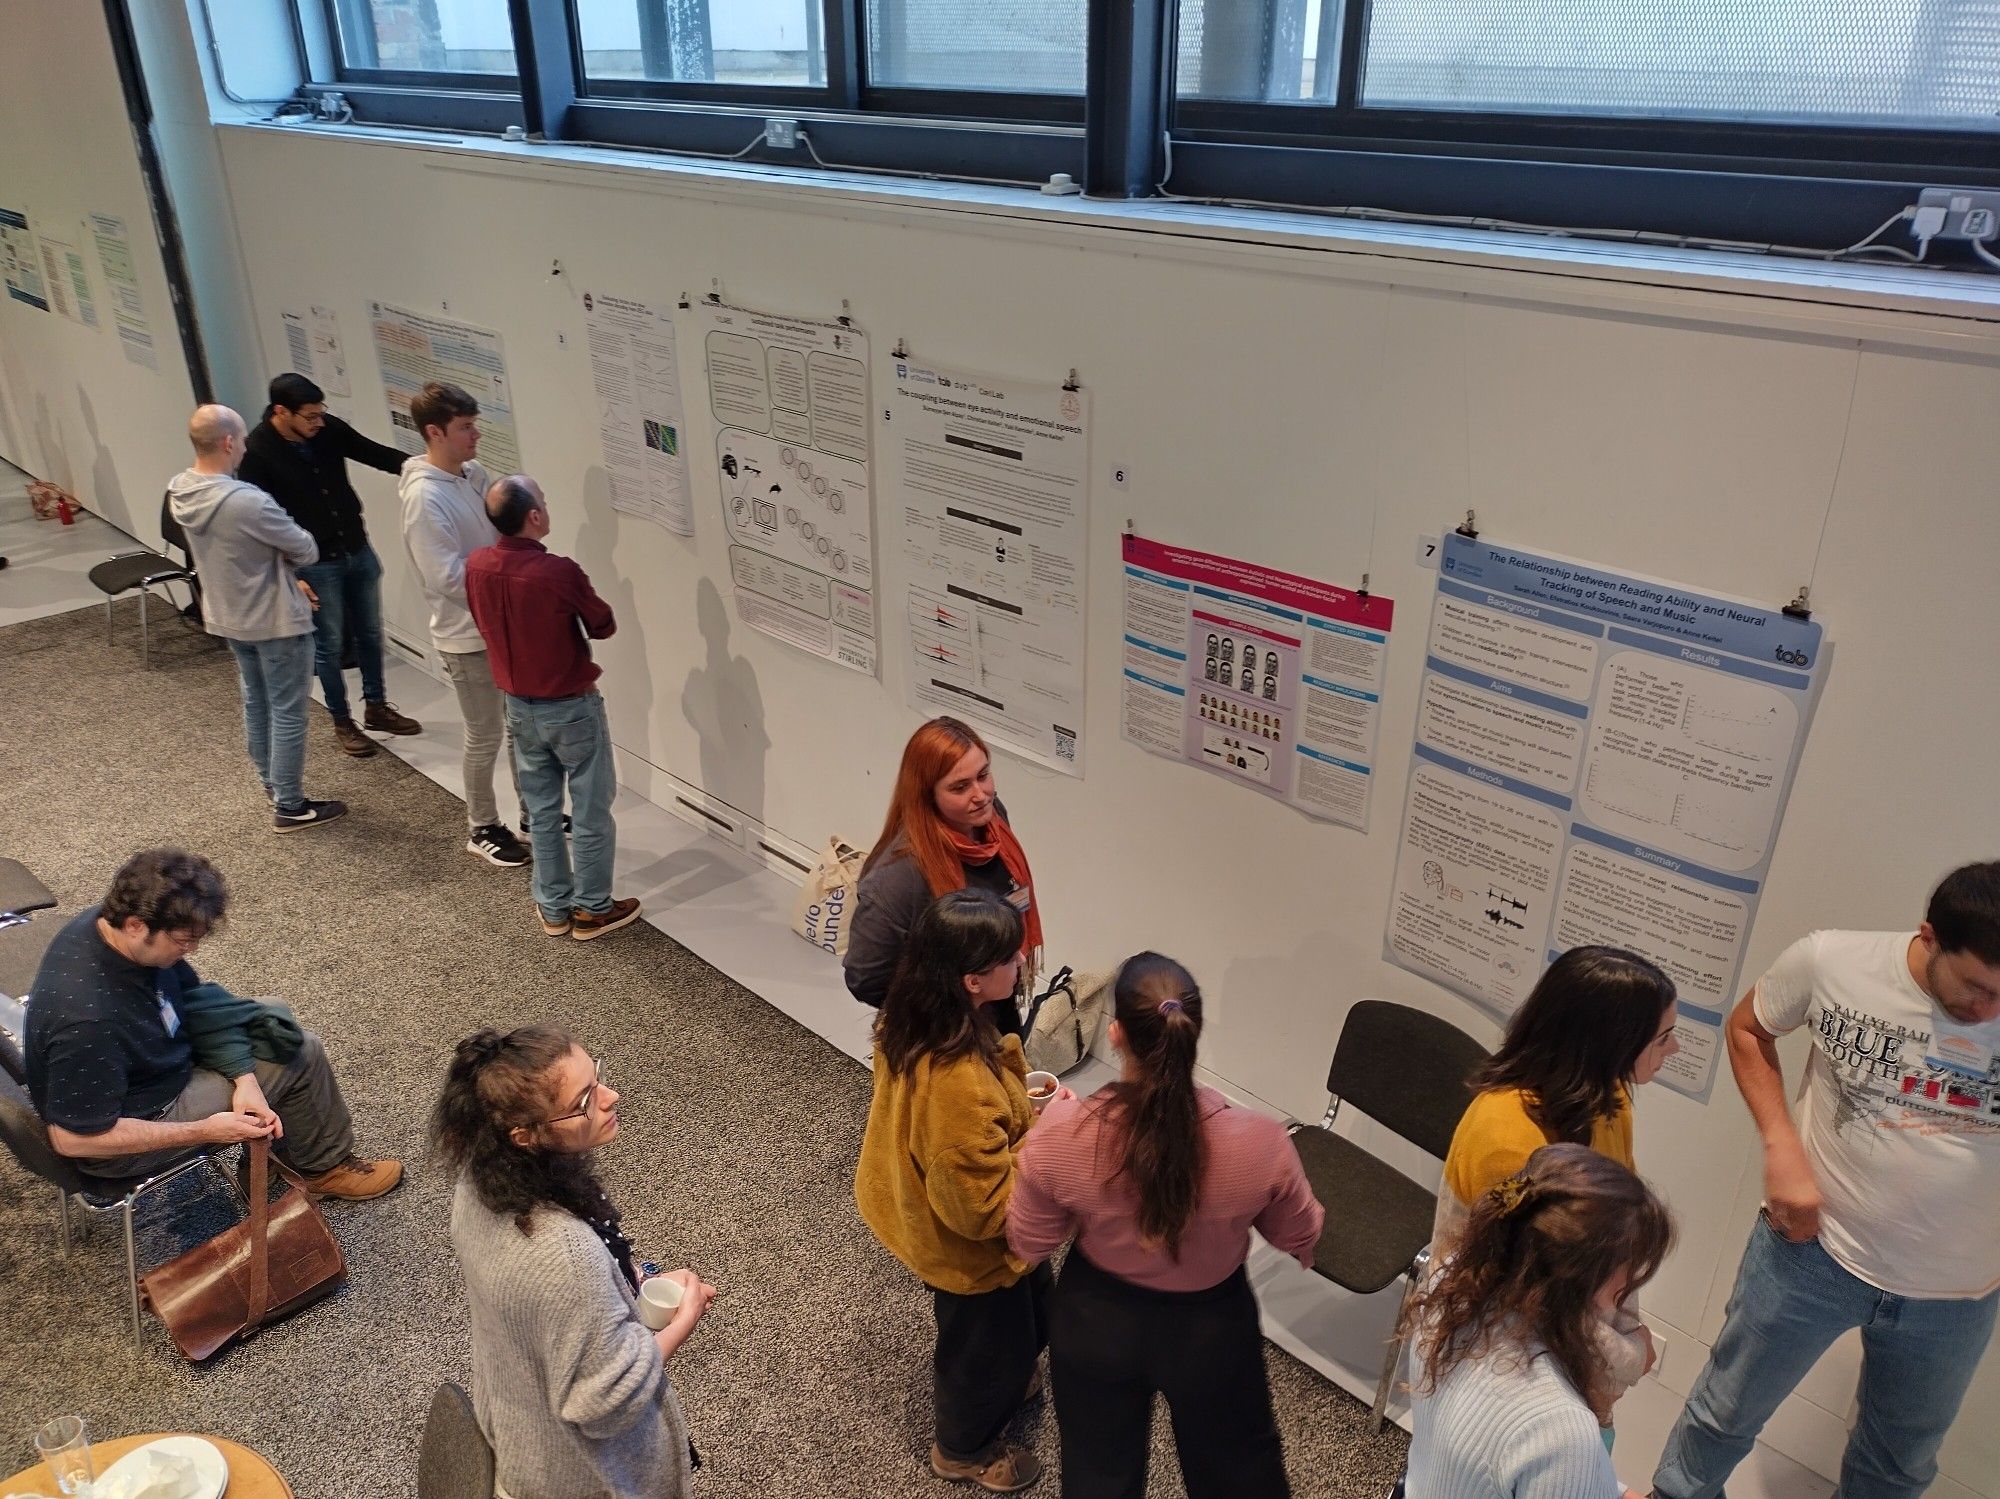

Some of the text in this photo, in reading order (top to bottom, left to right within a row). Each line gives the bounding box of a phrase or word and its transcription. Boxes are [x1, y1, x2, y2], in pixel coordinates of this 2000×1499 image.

[884, 410, 891, 421] 5
[896, 386, 909, 396] The
[910, 389, 937, 404] coupling
[938, 395, 966, 408] between
[967, 403, 978, 413] eye
[980, 404, 1004, 418] activity
[1005, 409, 1018, 420] and
[1020, 412, 1054, 427] emotional
[1055, 420, 1082, 435] speech
[1115, 470, 1123, 482] 6
[1425, 544, 1436, 557] 7
[1489, 551, 1766, 626] The Relationship between Reading Ability and Neural
[1487, 595, 1539, 617] Background
[1540, 577, 1696, 623] Tracking of Speech and Music
[1323, 622, 1346, 634] EXPECTED
[838, 651, 867, 669] STIRLING
[1681, 647, 1721, 666] Results
[1491, 680, 1513, 693] Aims
[1523, 711, 1545, 722] reading
[1468, 766, 1503, 785] Methods
[1634, 847, 1681, 871] Summary
[1820, 1007, 1903, 1065] BLUE
[1823, 1036, 1900, 1081] SOUTH
